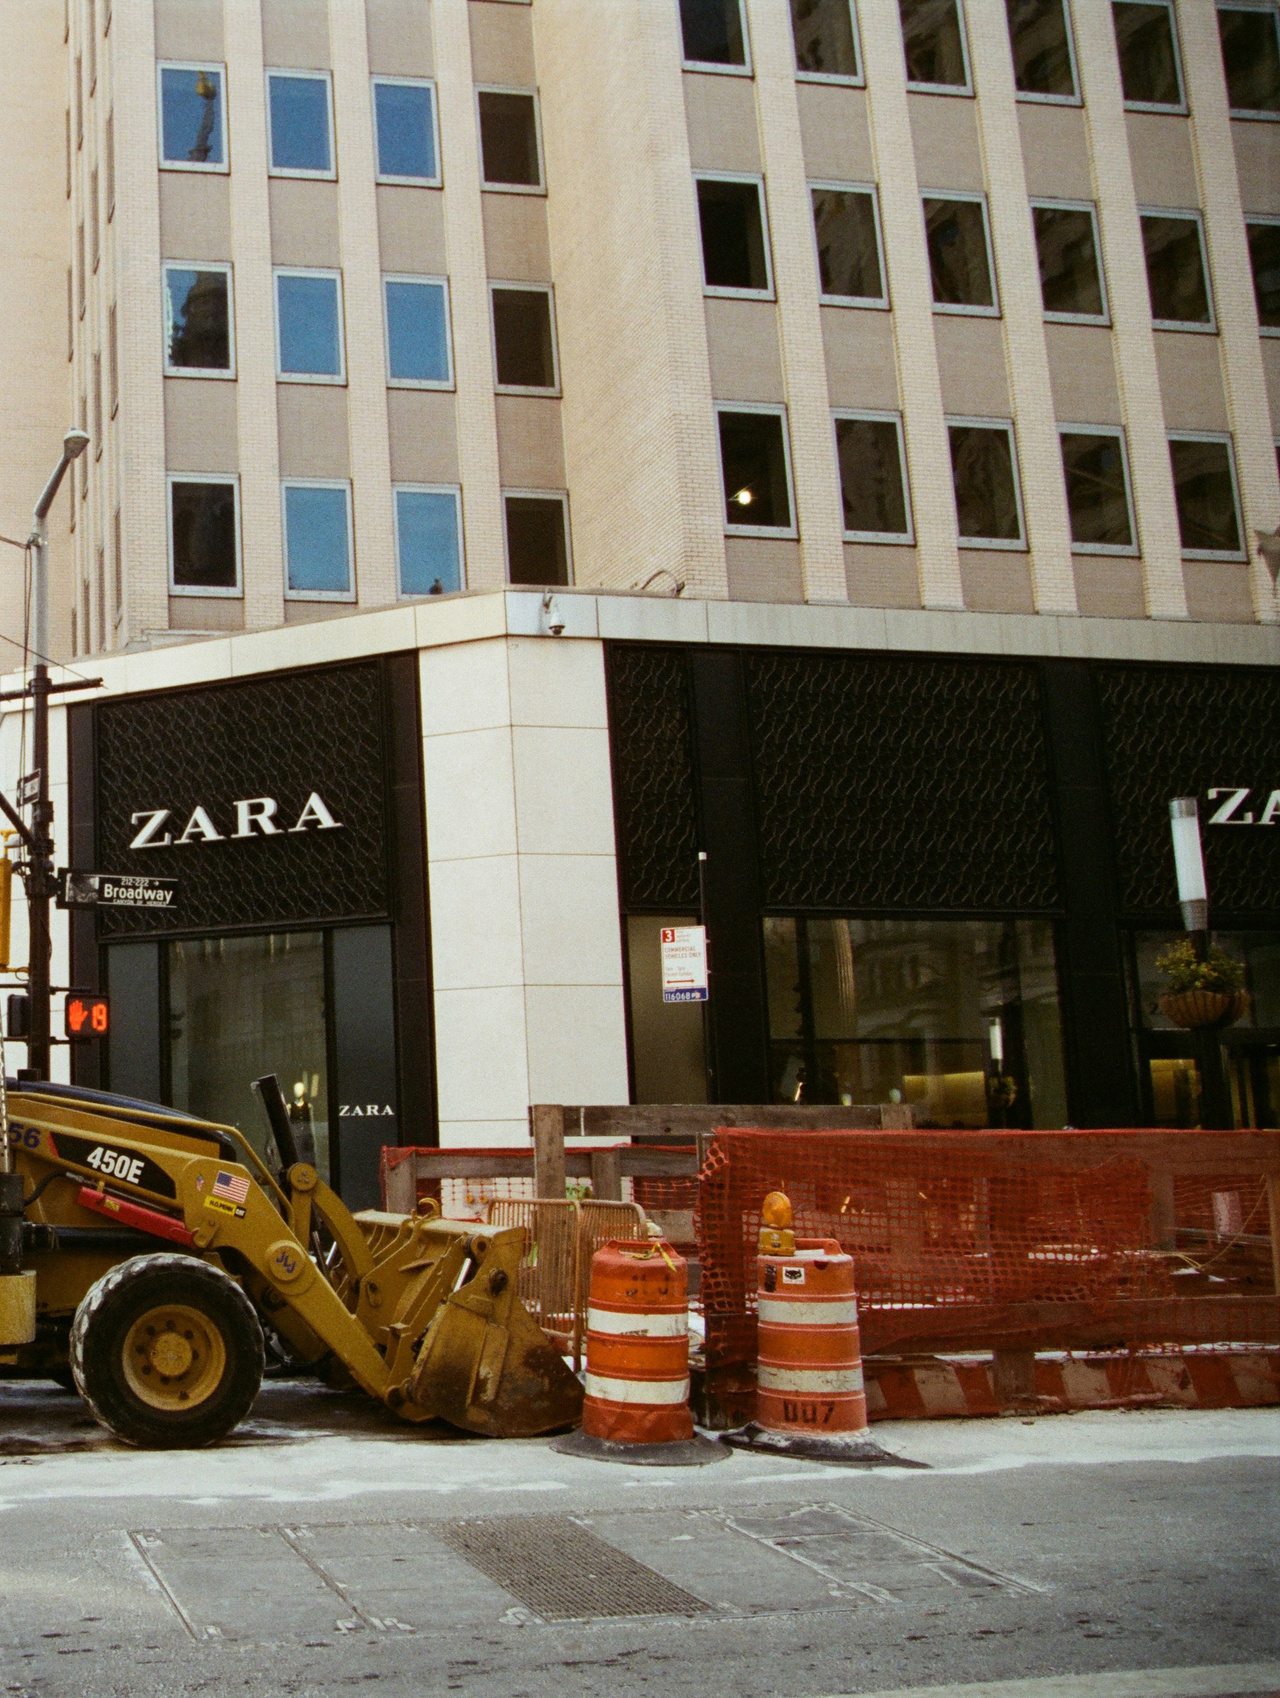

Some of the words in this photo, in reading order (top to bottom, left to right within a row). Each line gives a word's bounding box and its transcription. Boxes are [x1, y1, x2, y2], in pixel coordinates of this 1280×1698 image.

[130, 791, 345, 849] ZARA
[121, 877, 150, 887] 212-222
[104, 883, 174, 905] Broadway
[665, 930, 673, 942] 3
[665, 991, 691, 1001] 116068
[92, 1003, 108, 1031] 19
[339, 1104, 395, 1117] ZARA
[86, 1146, 145, 1184] 450E
[276, 1250, 298, 1274] JLJ
